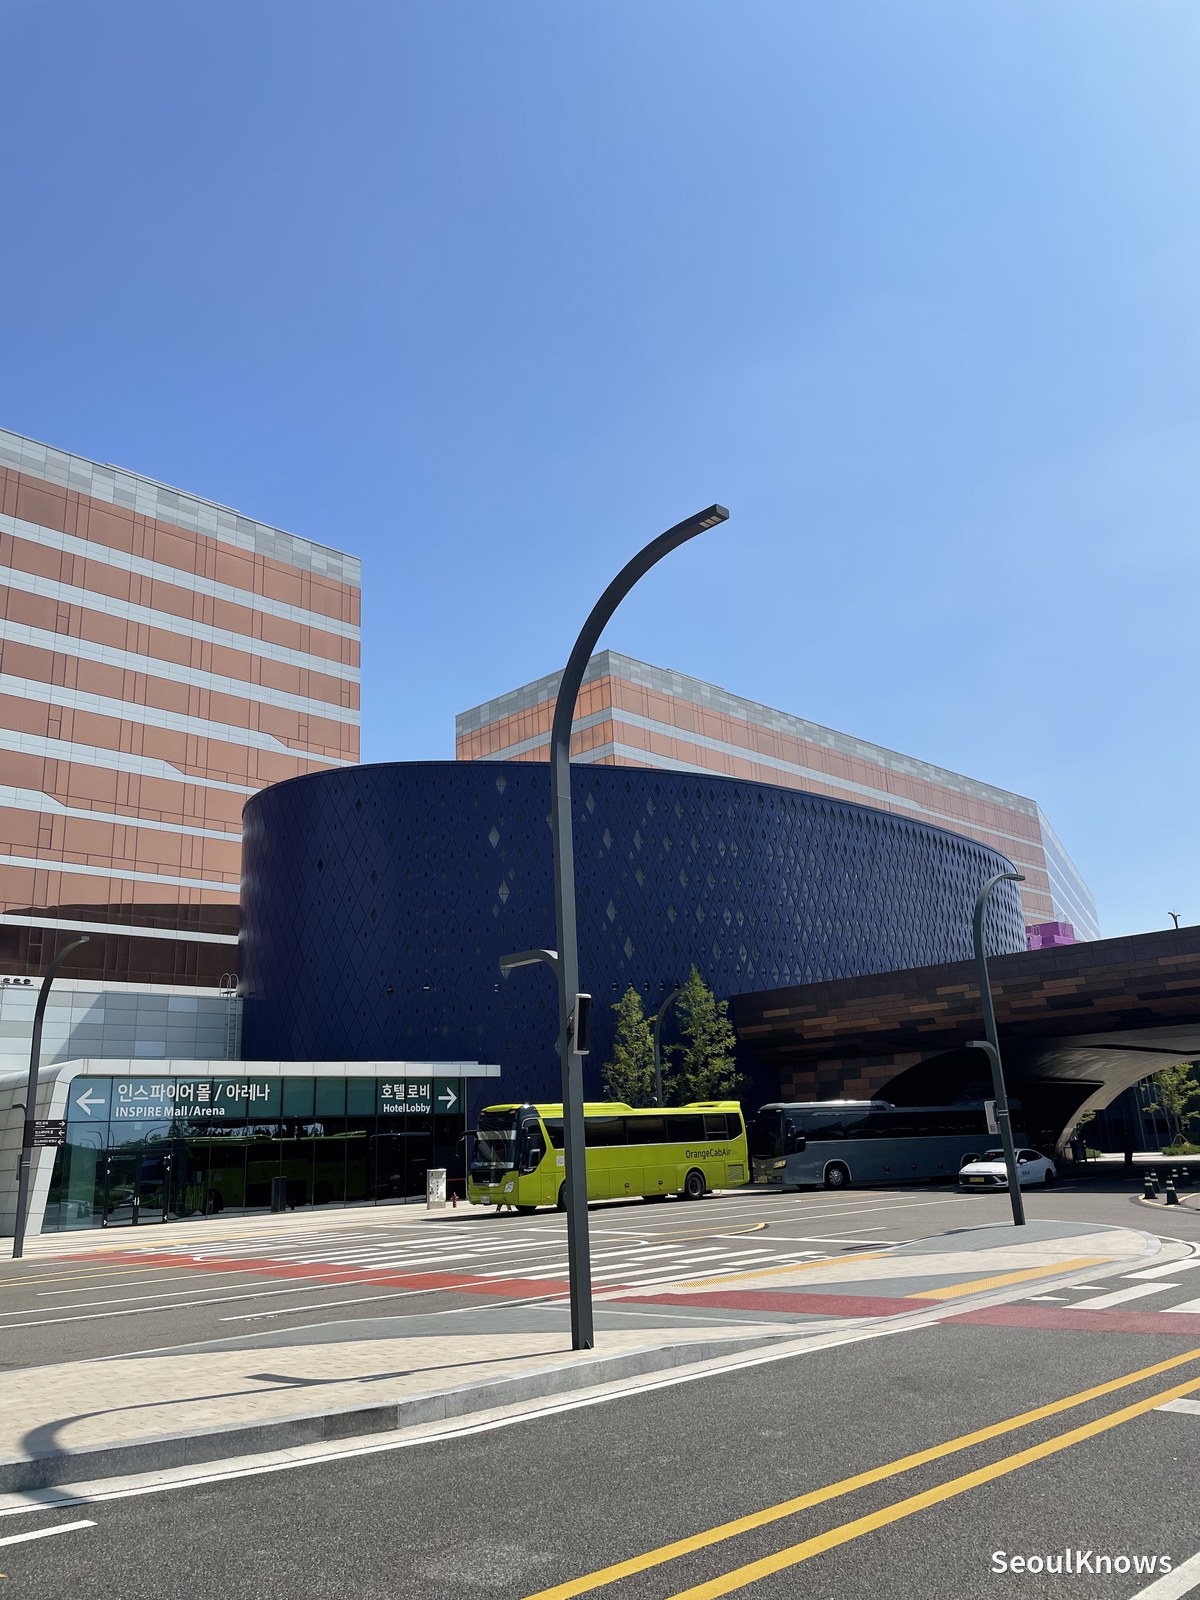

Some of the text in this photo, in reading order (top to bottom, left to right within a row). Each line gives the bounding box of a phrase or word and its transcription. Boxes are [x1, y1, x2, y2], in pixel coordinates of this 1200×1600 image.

[226, 1083, 270, 1101] 아레나
[115, 1106, 161, 1117] INSPIRE
[685, 1148, 731, 1159] OrangeCabAir
